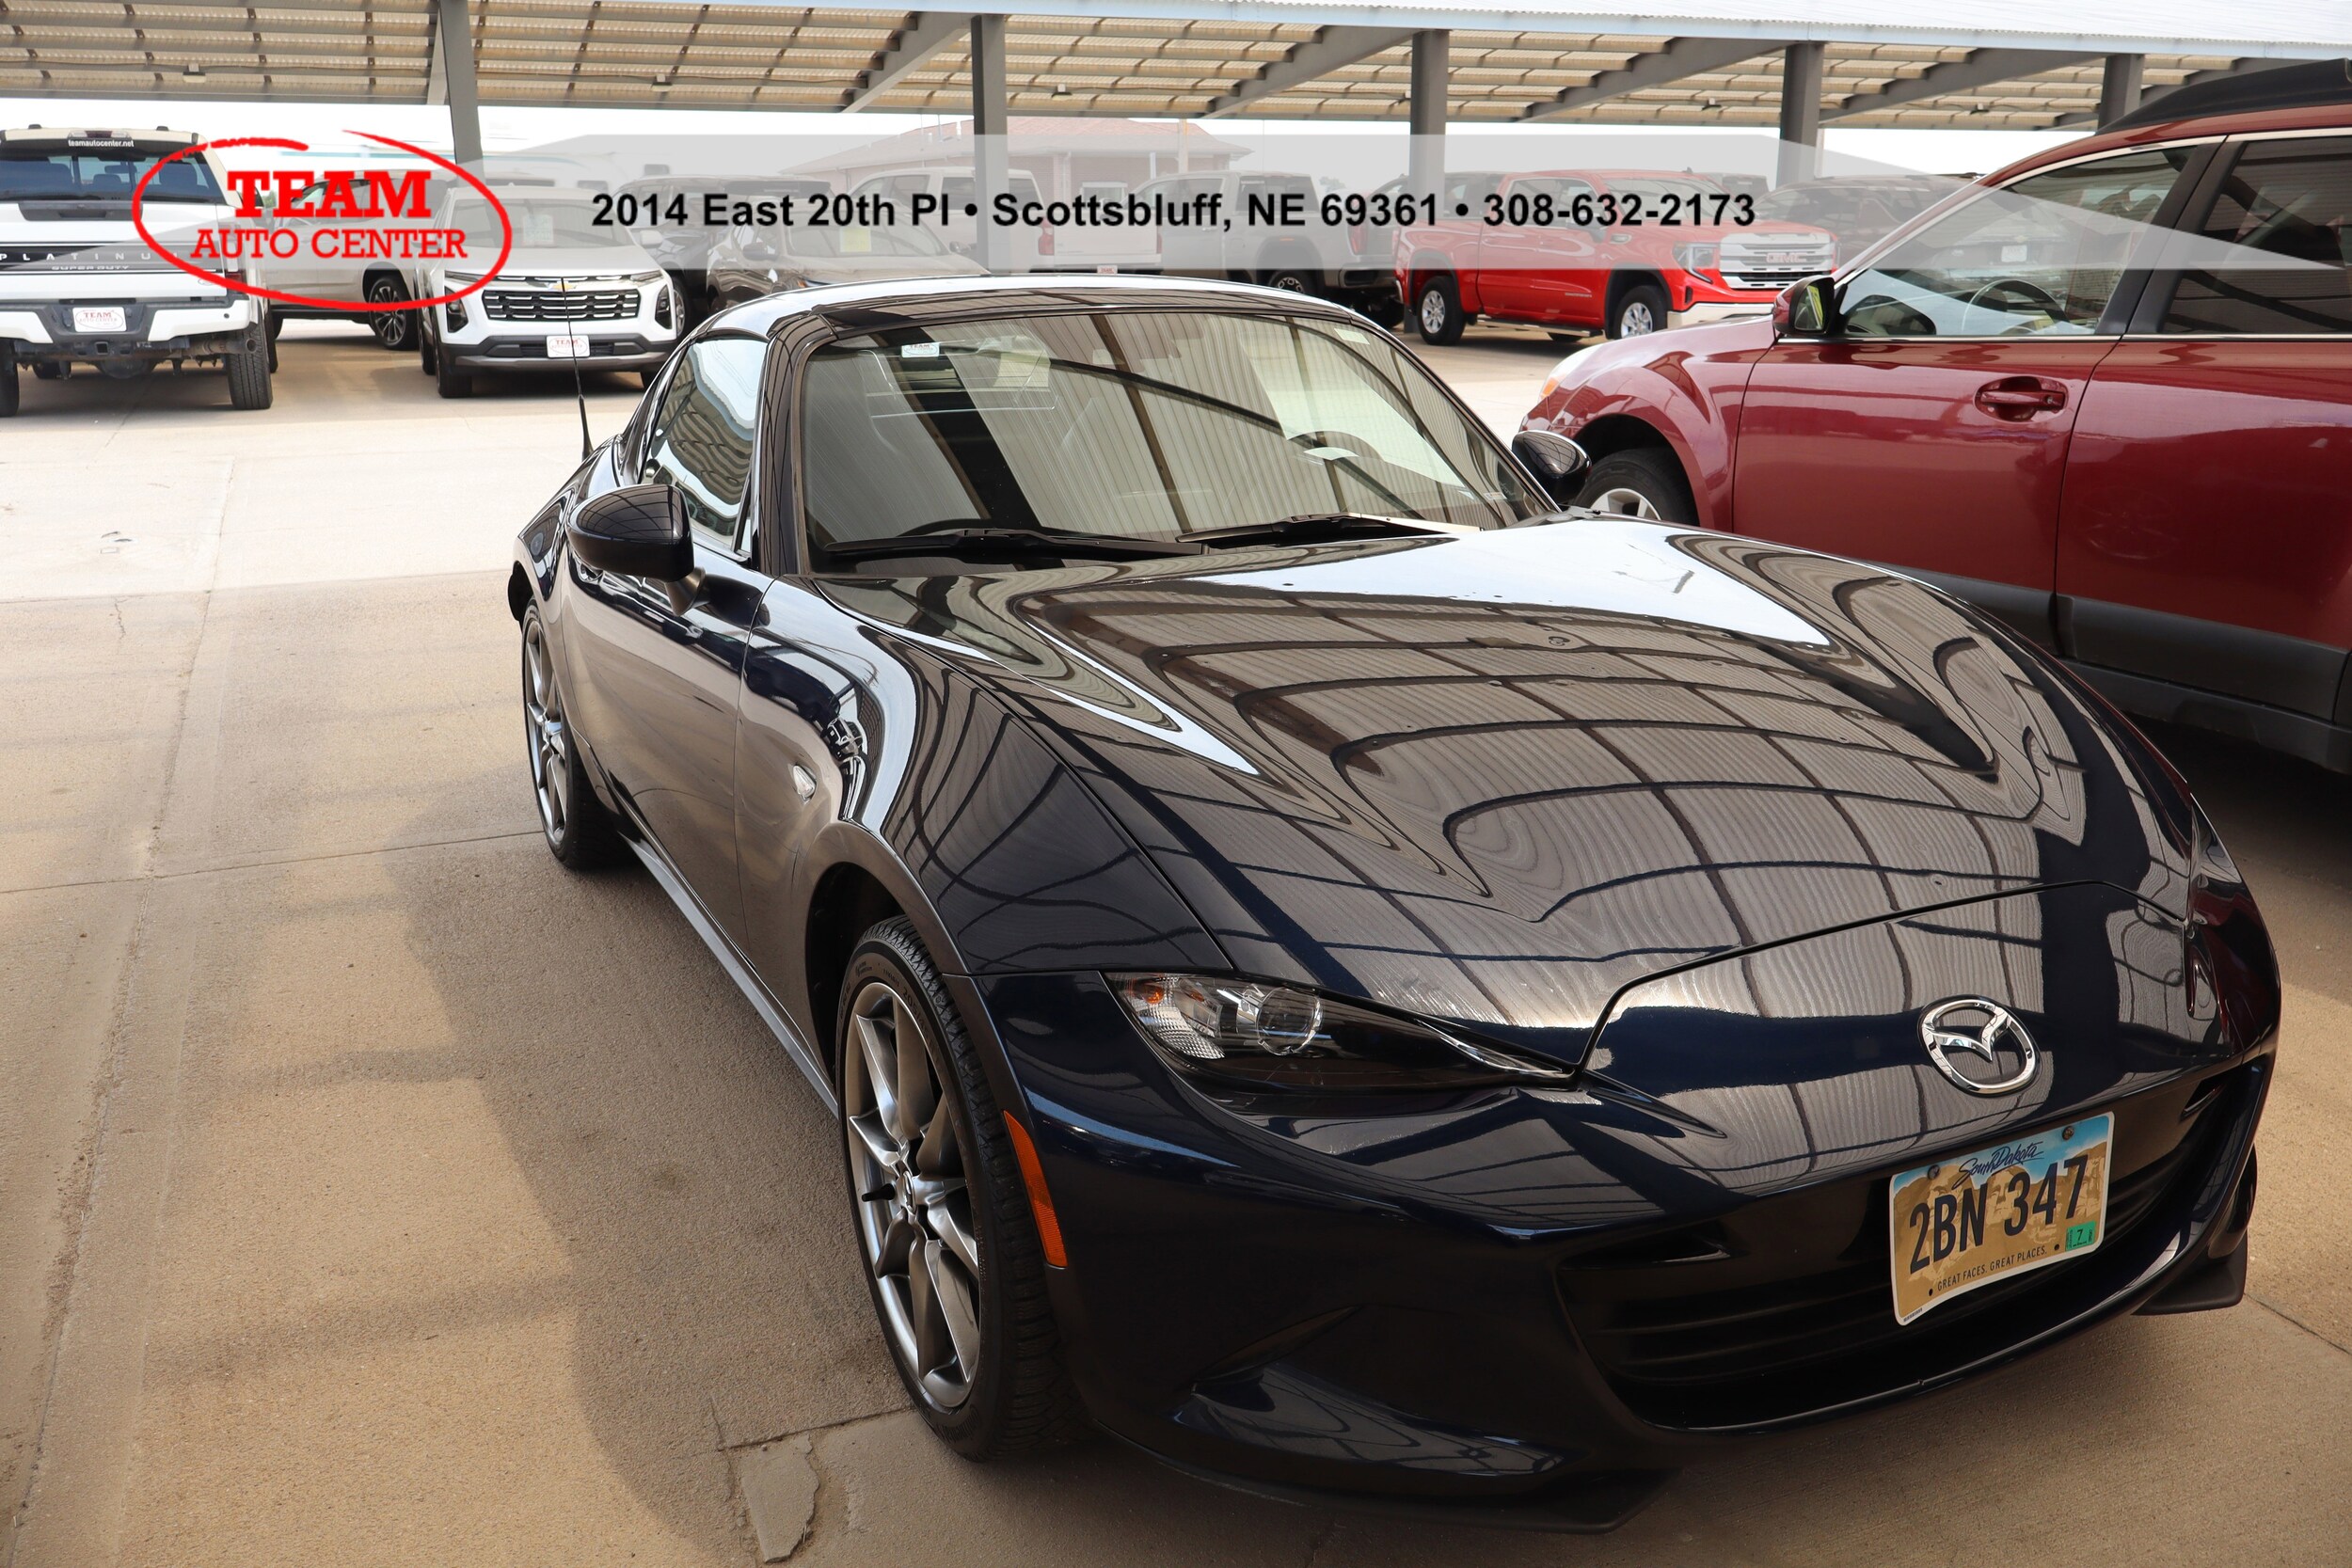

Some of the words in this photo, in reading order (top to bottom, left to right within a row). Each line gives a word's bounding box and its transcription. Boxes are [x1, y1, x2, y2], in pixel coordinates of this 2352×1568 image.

[68, 139, 135, 148] teamautocenter.net
[1766, 252, 1806, 263] GMC
[1992, 1141, 2044, 1171] Dakota
[1909, 1182, 1989, 1275] 2BN
[2004, 1154, 2089, 1237] 347
[2077, 1228, 2084, 1241] 7
[1937, 1273, 1961, 1291] GREAT
[1963, 1264, 1988, 1280] FACES.
[1990, 1255, 2015, 1272] GREAT
[2016, 1245, 2047, 1262] PLACES.
